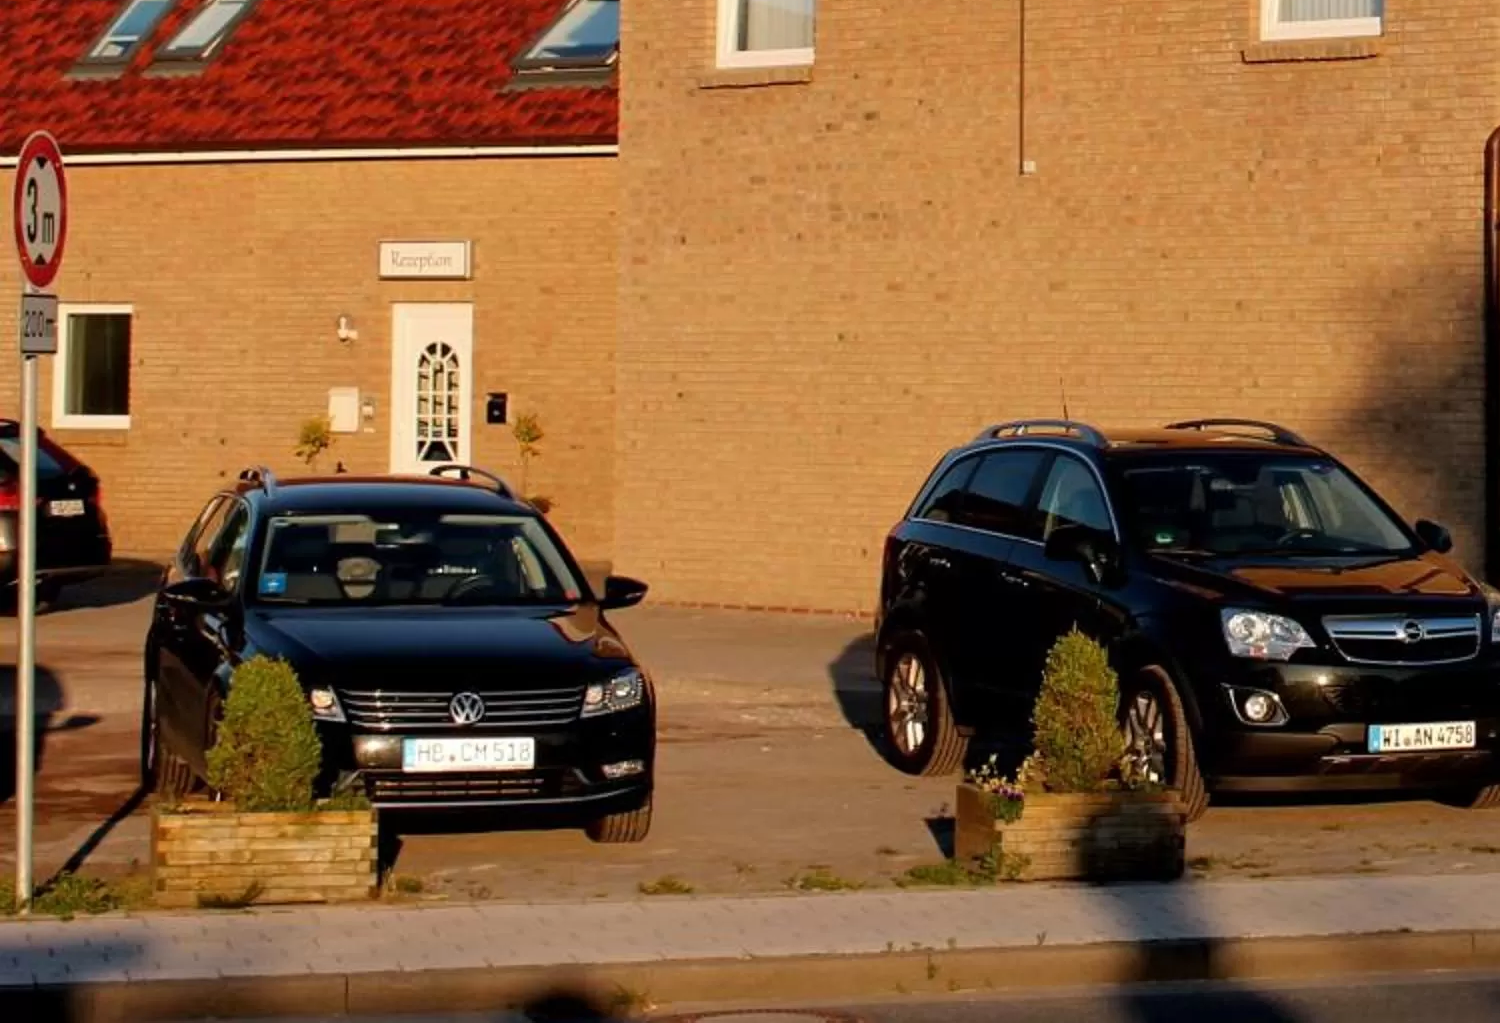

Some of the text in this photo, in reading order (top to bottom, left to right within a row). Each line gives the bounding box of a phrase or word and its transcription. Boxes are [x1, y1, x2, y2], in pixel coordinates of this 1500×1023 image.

[27, 178, 55, 244] 3 m
[1383, 724, 1473, 747] WI AN 4758
[460, 741, 487, 763] CM
[492, 740, 531, 762] 518
